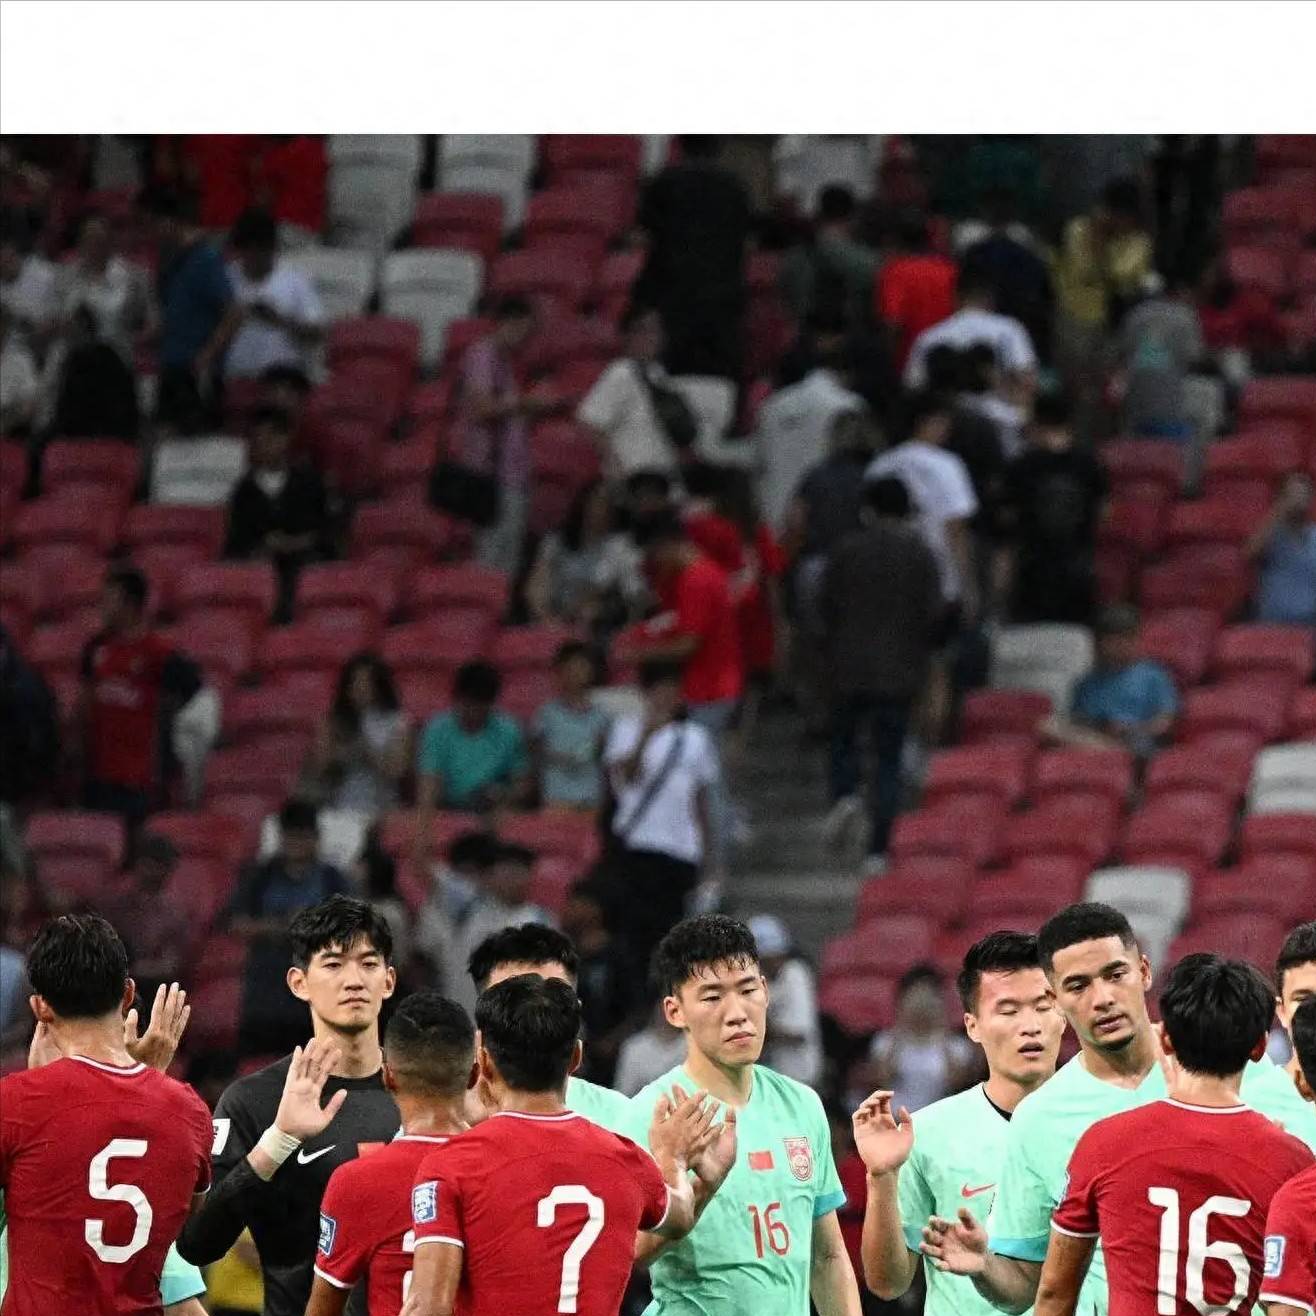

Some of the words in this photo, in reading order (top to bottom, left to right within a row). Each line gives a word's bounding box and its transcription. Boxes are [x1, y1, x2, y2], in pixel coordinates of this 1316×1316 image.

[84, 1138, 153, 1264] 5
[537, 1184, 605, 1314] 7
[747, 1202, 789, 1259] 16
